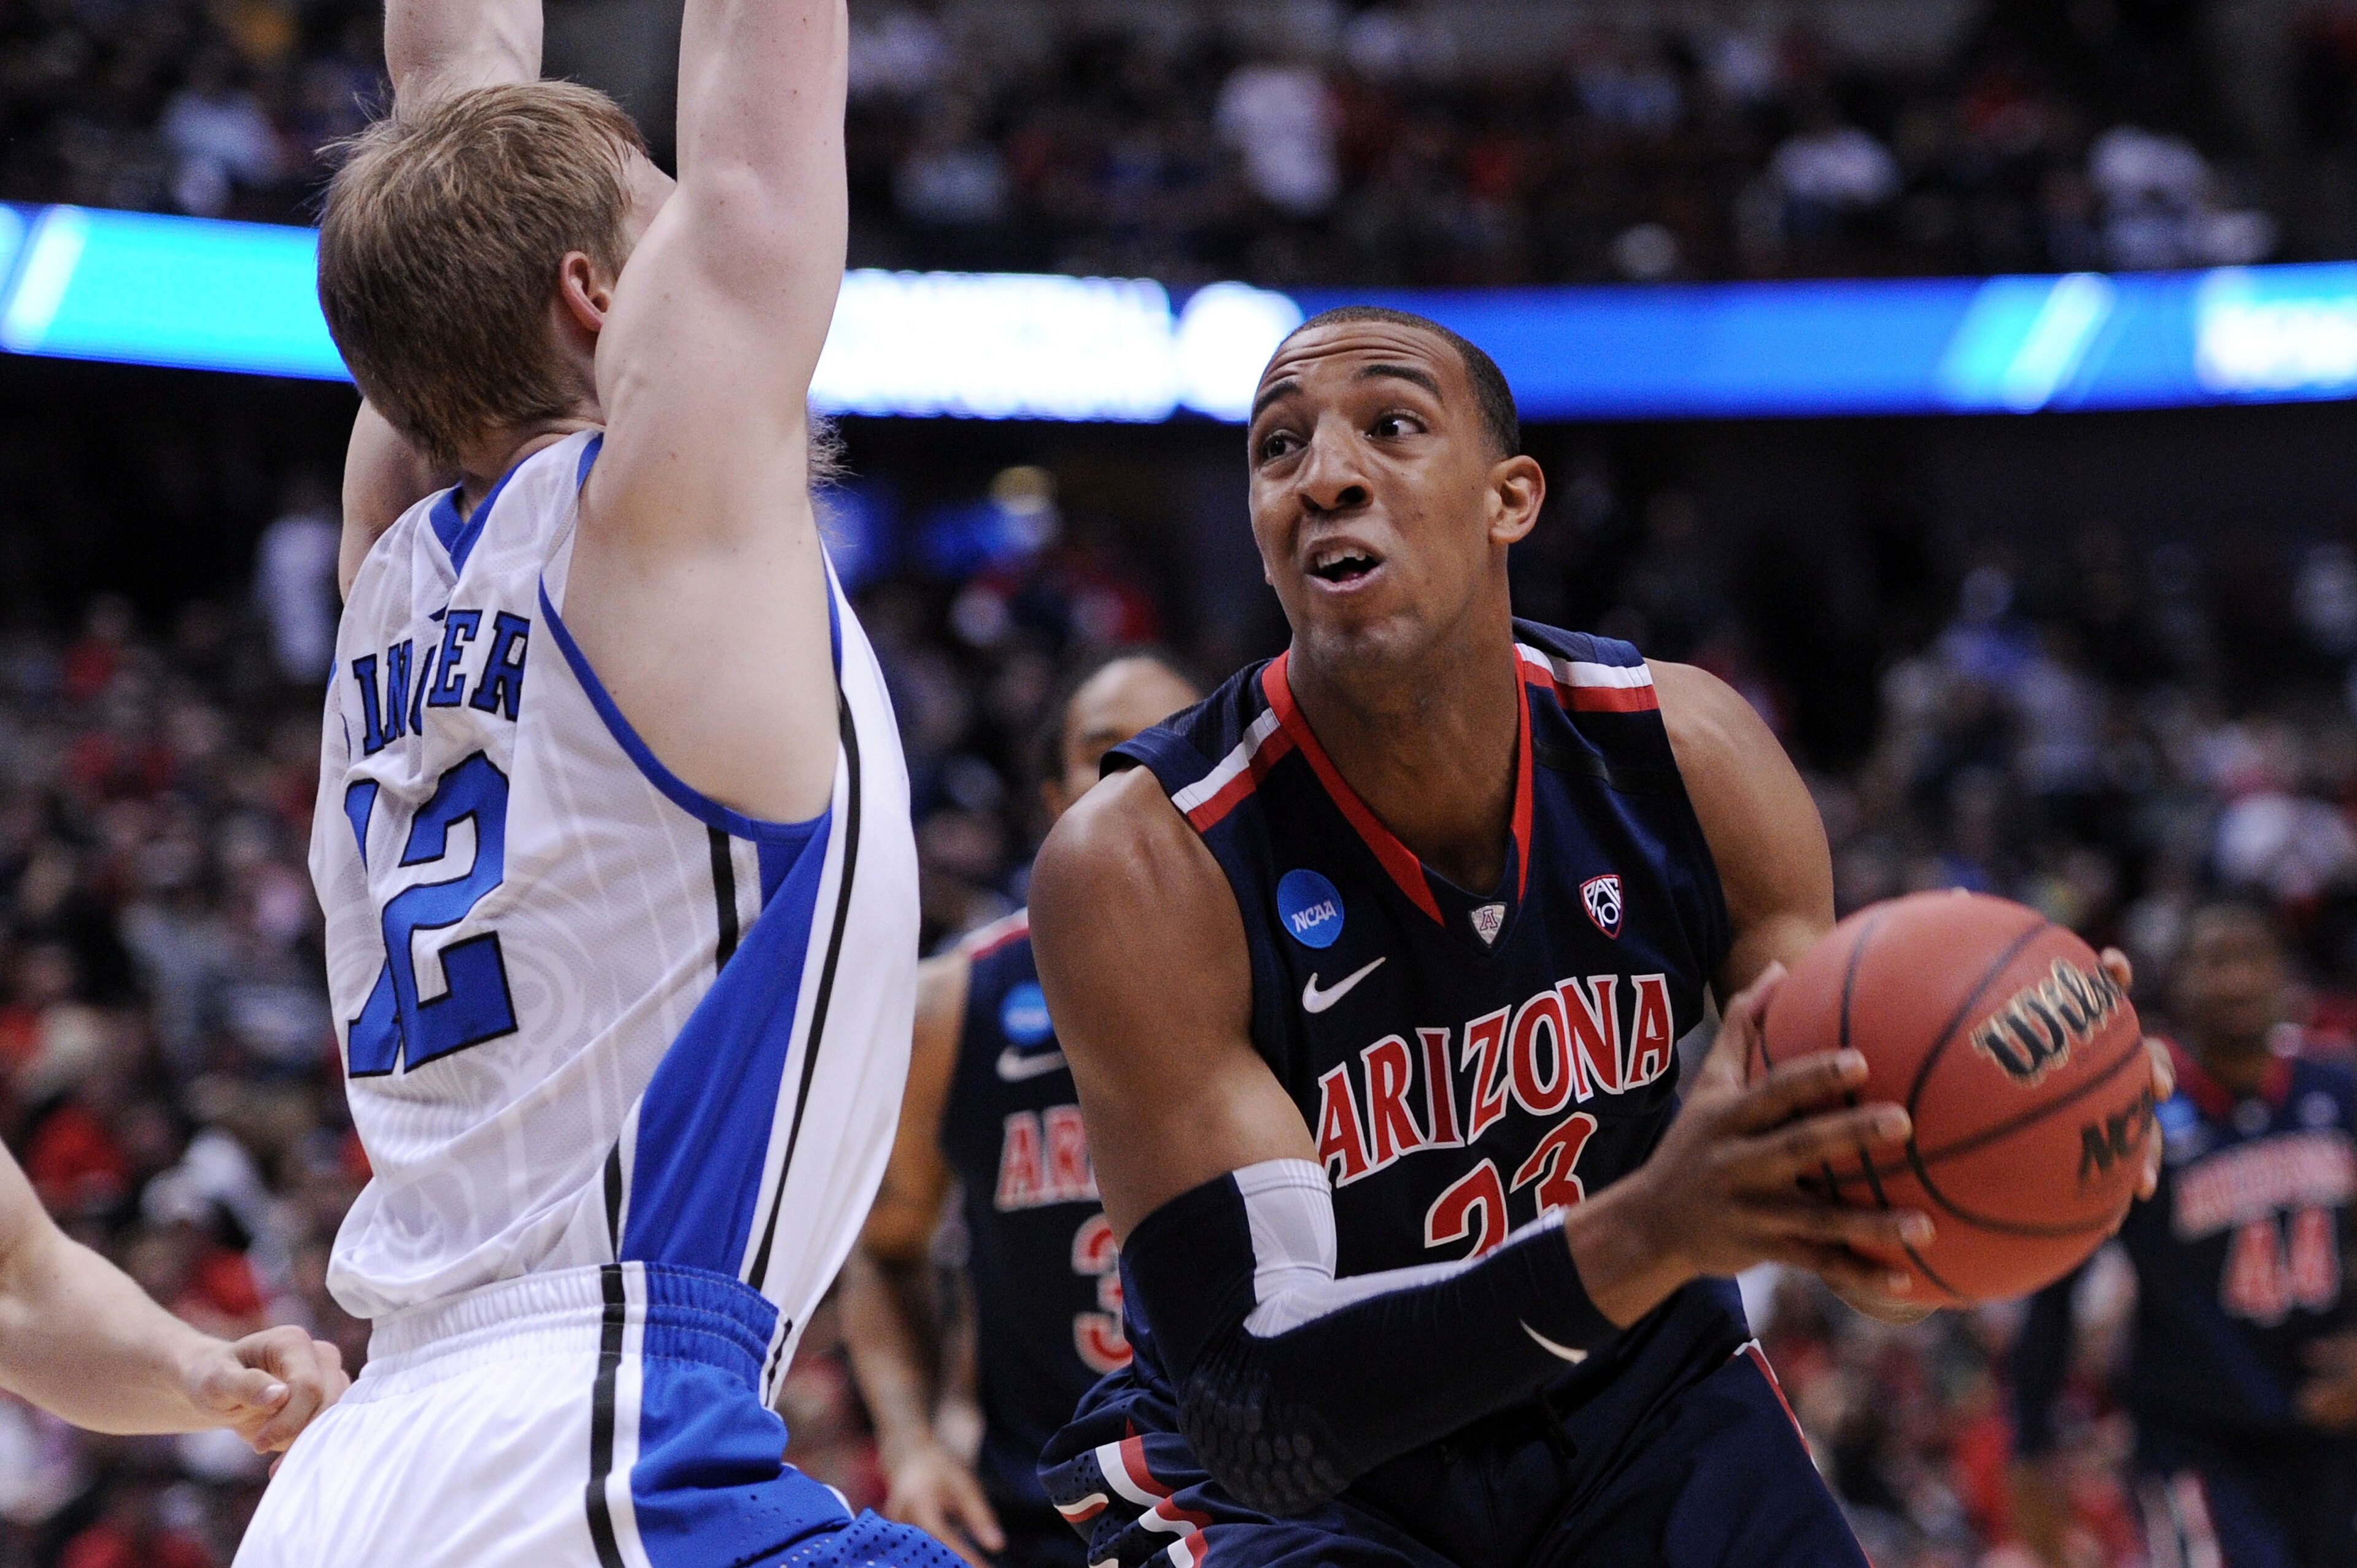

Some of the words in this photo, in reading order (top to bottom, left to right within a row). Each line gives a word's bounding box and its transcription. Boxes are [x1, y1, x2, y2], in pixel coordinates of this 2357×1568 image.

[339, 609, 530, 760] INER
[344, 749, 517, 1078] 12
[1293, 901, 1336, 932] NCAA
[1583, 878, 1621, 917] PAC
[1596, 902, 1619, 927] 10
[1316, 973, 1673, 1188] ARIZONA
[995, 1105, 1099, 1211] AR
[1424, 1112, 1597, 1262] 23
